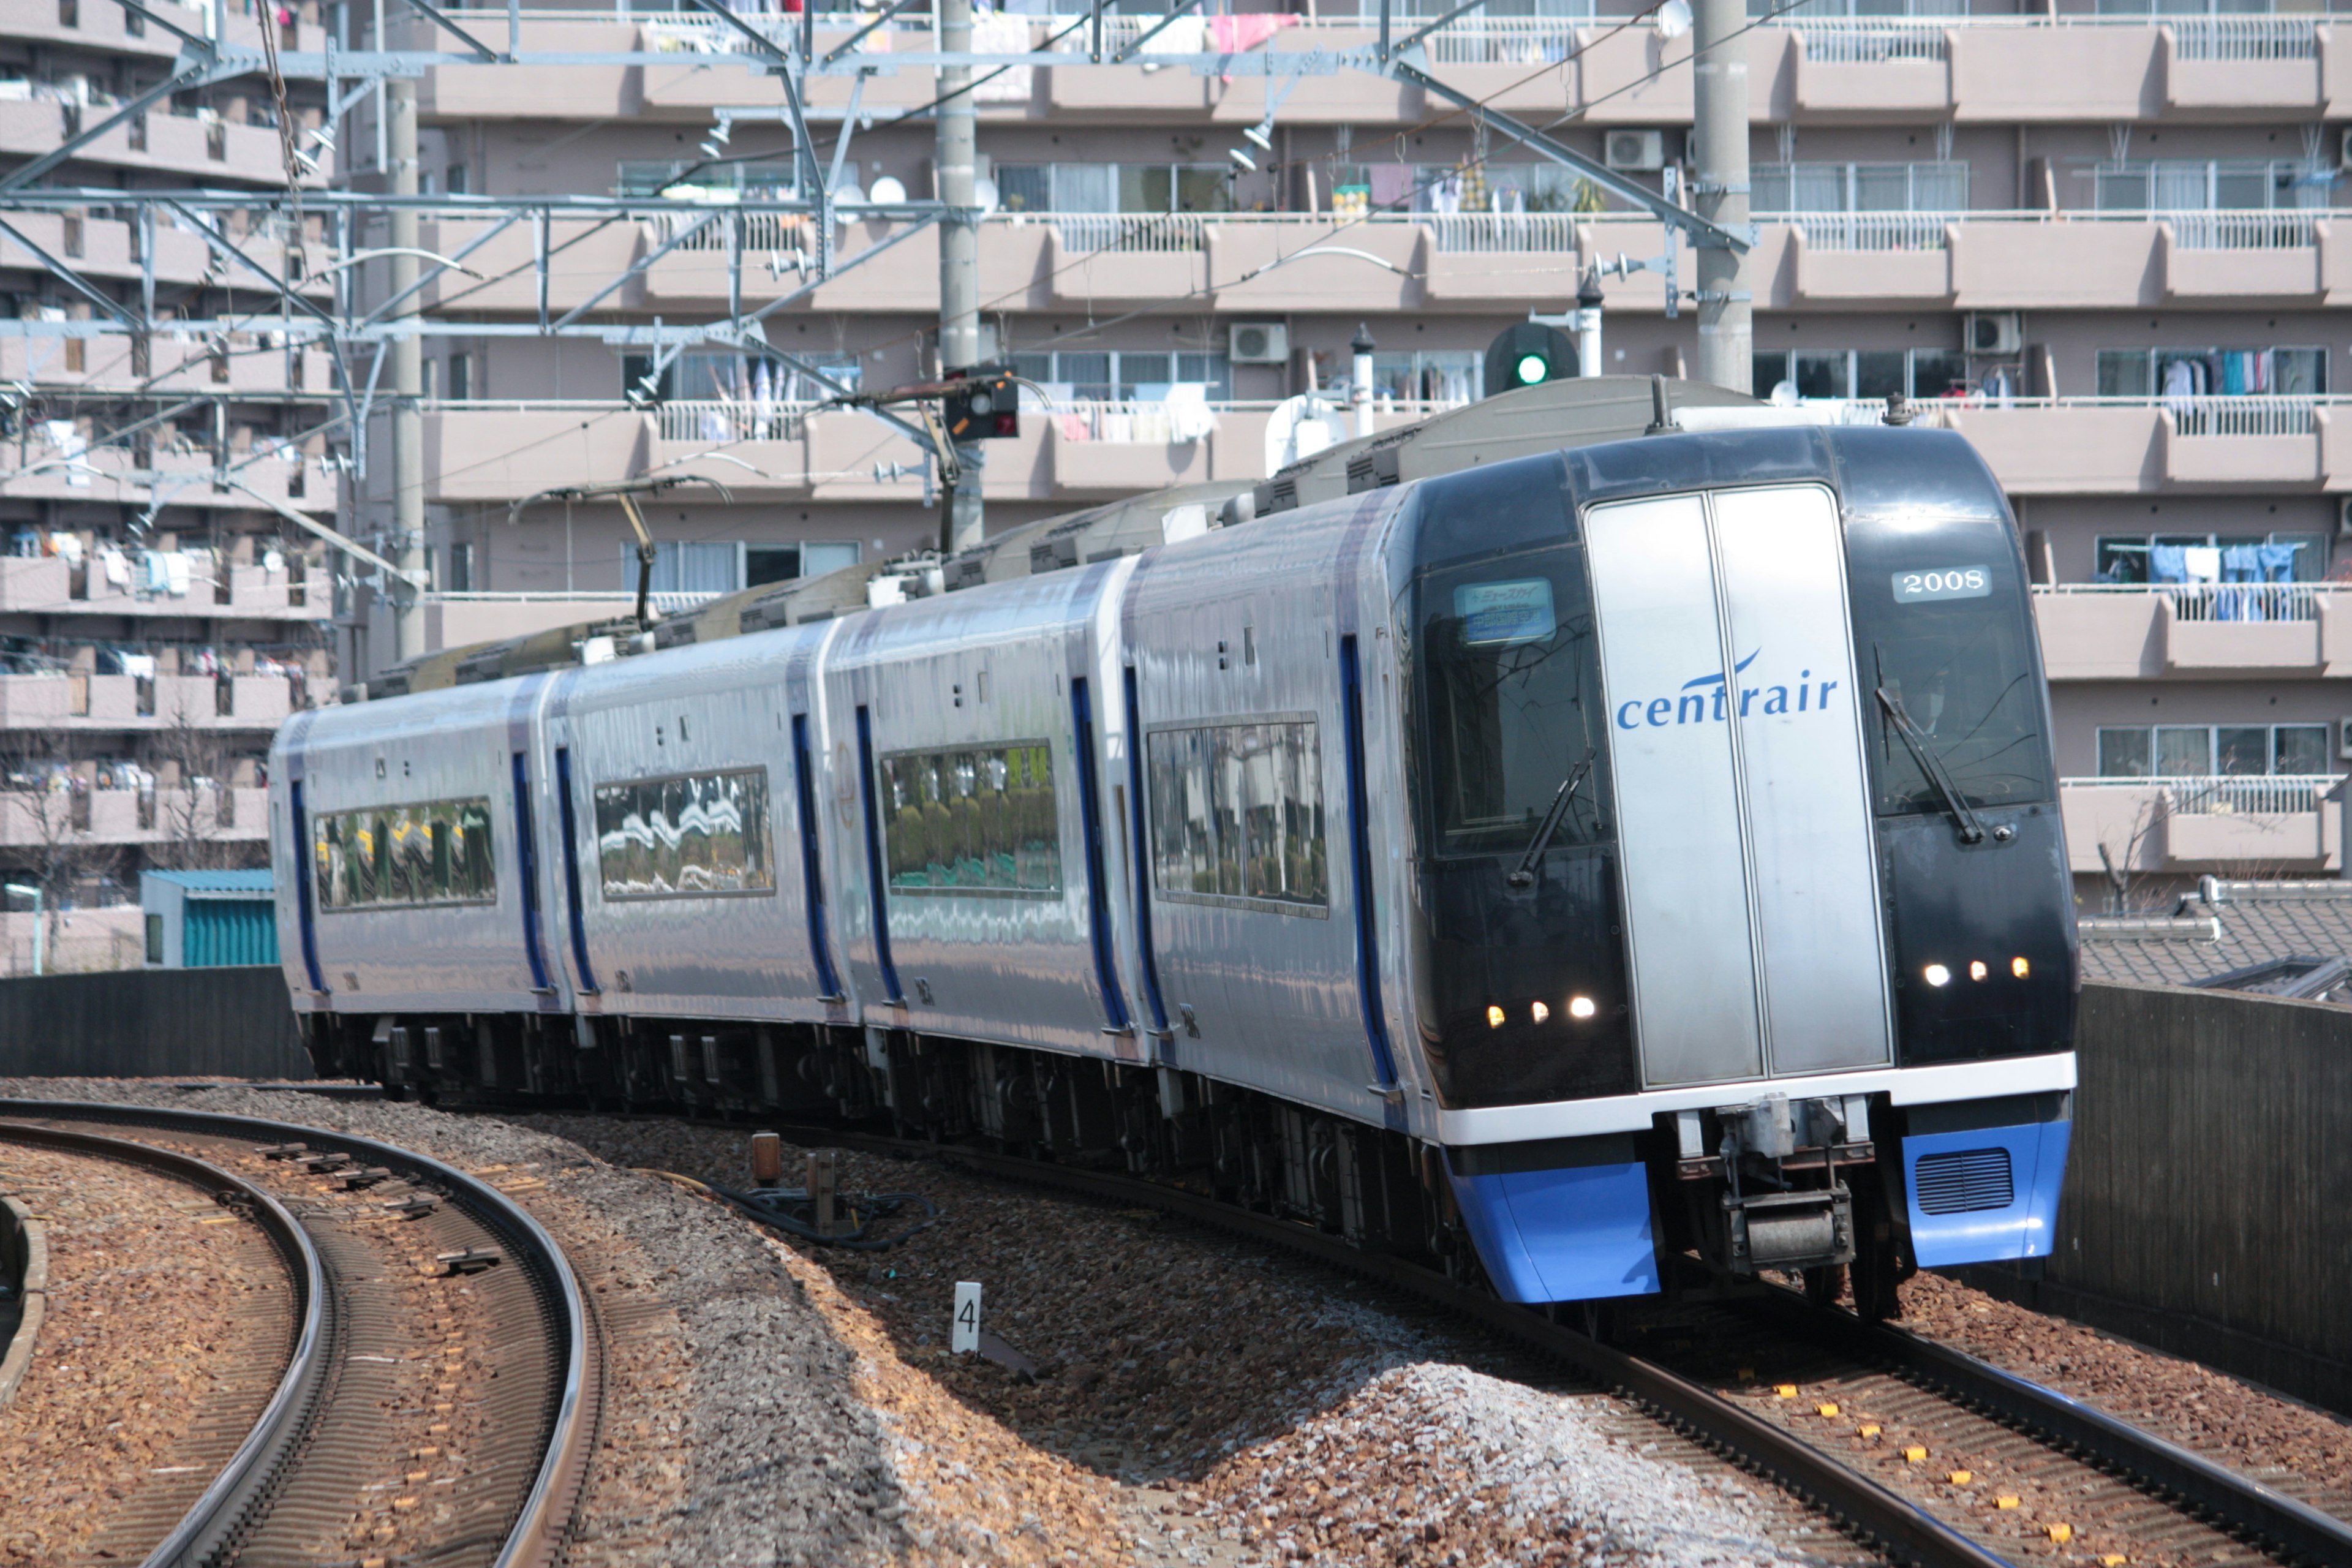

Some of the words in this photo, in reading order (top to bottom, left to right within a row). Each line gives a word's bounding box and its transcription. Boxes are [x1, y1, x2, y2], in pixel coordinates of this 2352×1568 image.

[1903, 570, 1984, 594] 2008
[1473, 610, 1542, 628] 中部国際空港
[1617, 669, 1838, 729] centrair
[958, 1298, 976, 1333] 4
